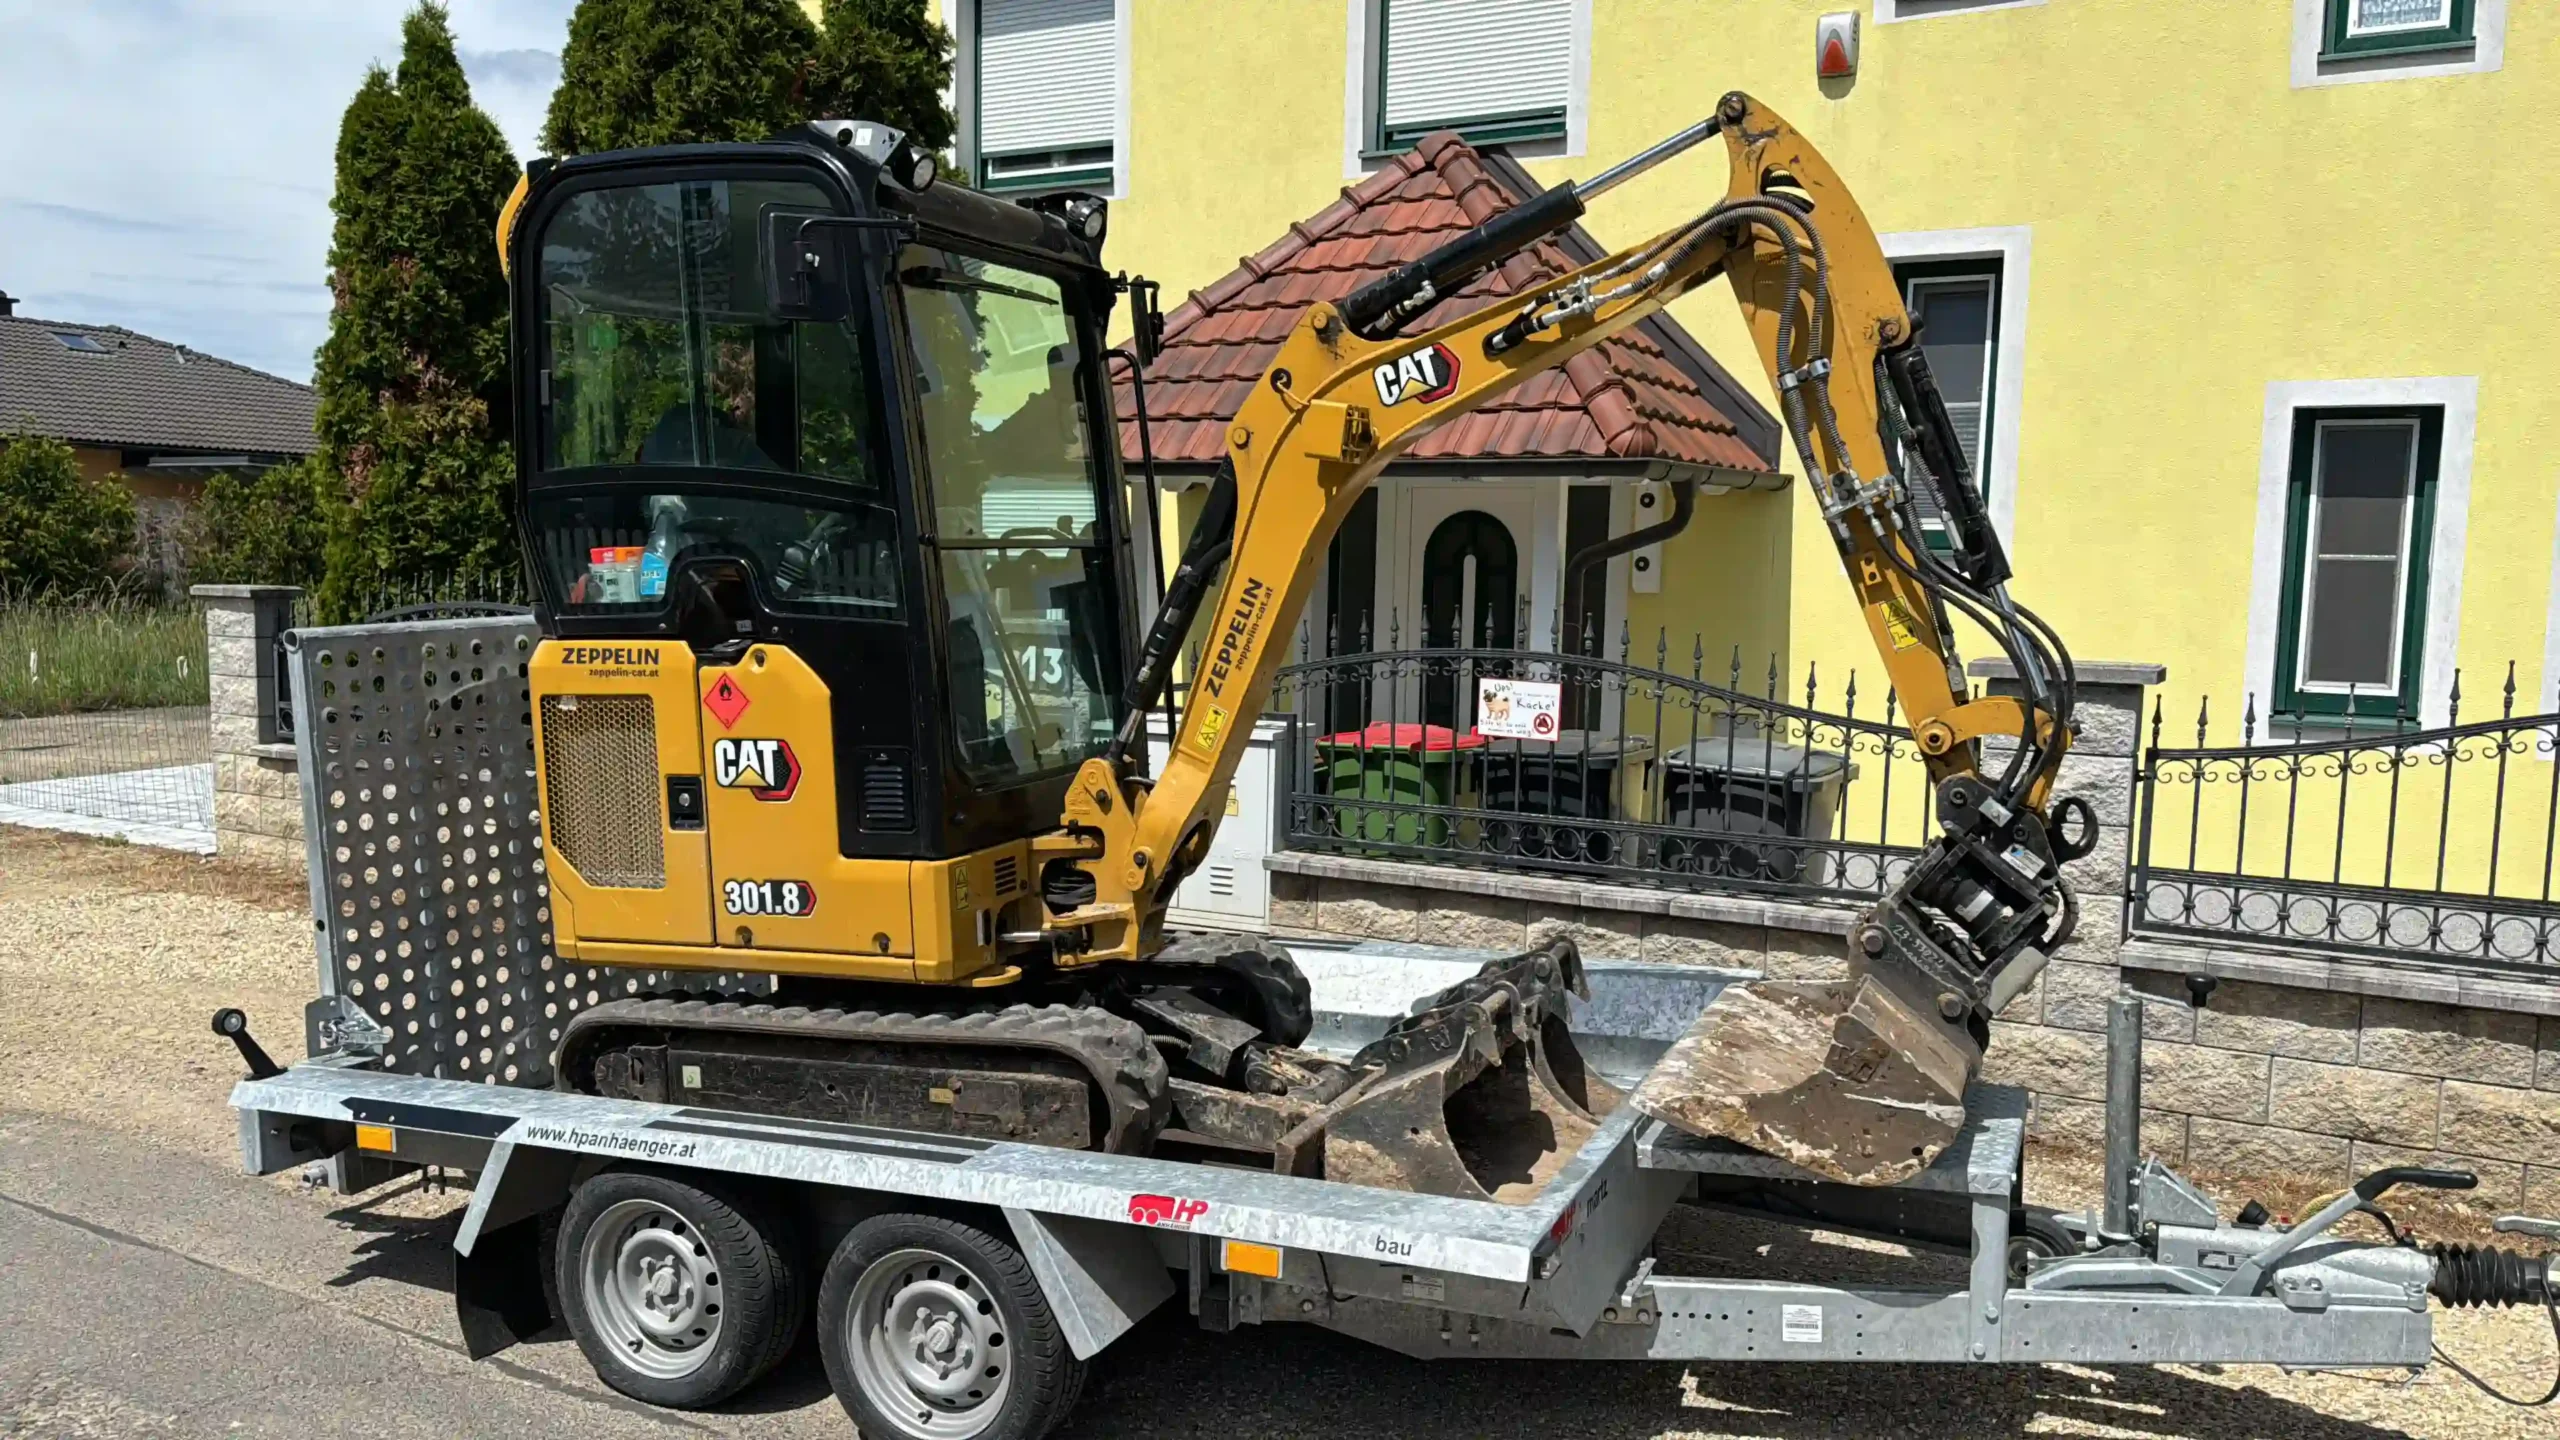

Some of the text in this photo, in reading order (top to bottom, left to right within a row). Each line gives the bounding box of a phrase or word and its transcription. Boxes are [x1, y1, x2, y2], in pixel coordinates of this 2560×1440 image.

[1374, 346, 1438, 406] CAT
[1204, 576, 1264, 698] ZEPPELIN
[1235, 586, 1274, 671] zeppelin-cat.at
[561, 647, 660, 665] ZEPPELIN
[588, 667, 659, 678] zeppelin-cat.at
[1021, 645, 1064, 684] 13
[714, 739, 778, 788] CAT
[724, 880, 800, 915] 301.8
[527, 1125, 697, 1158] www.hpanhaenger.at
[1174, 1198, 1209, 1222] HP
[1375, 1234, 1412, 1257] bau
